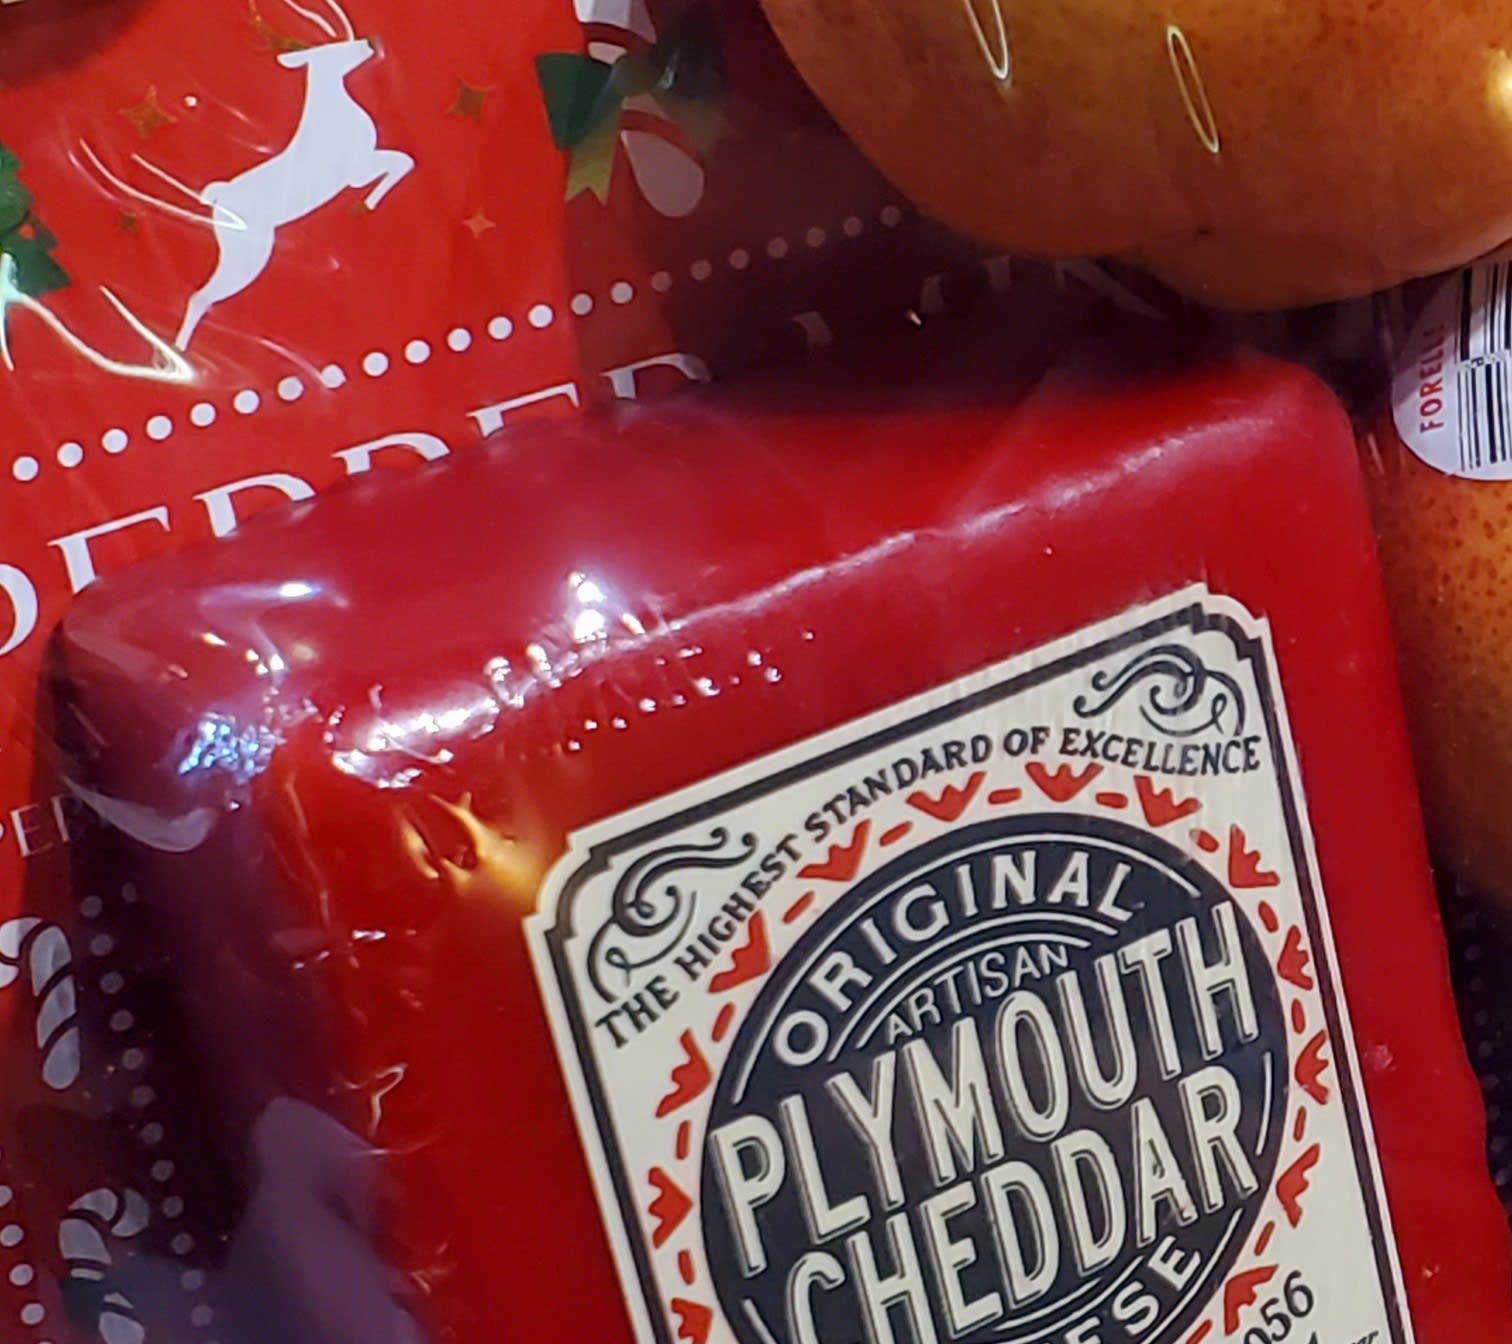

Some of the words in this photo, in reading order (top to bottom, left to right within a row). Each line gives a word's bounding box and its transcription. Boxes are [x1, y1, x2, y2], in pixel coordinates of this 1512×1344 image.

[595, 974, 681, 1048] THE
[674, 833, 803, 982] HIGHEST
[804, 733, 993, 843] STANDARD
[1003, 725, 1050, 757] OF
[1058, 726, 1262, 777] EXCELLENCE
[772, 850, 1134, 1066] ORIGINAL
[886, 944, 1070, 1045] ARTISAN
[710, 901, 1260, 1278] PLYMOUTH
